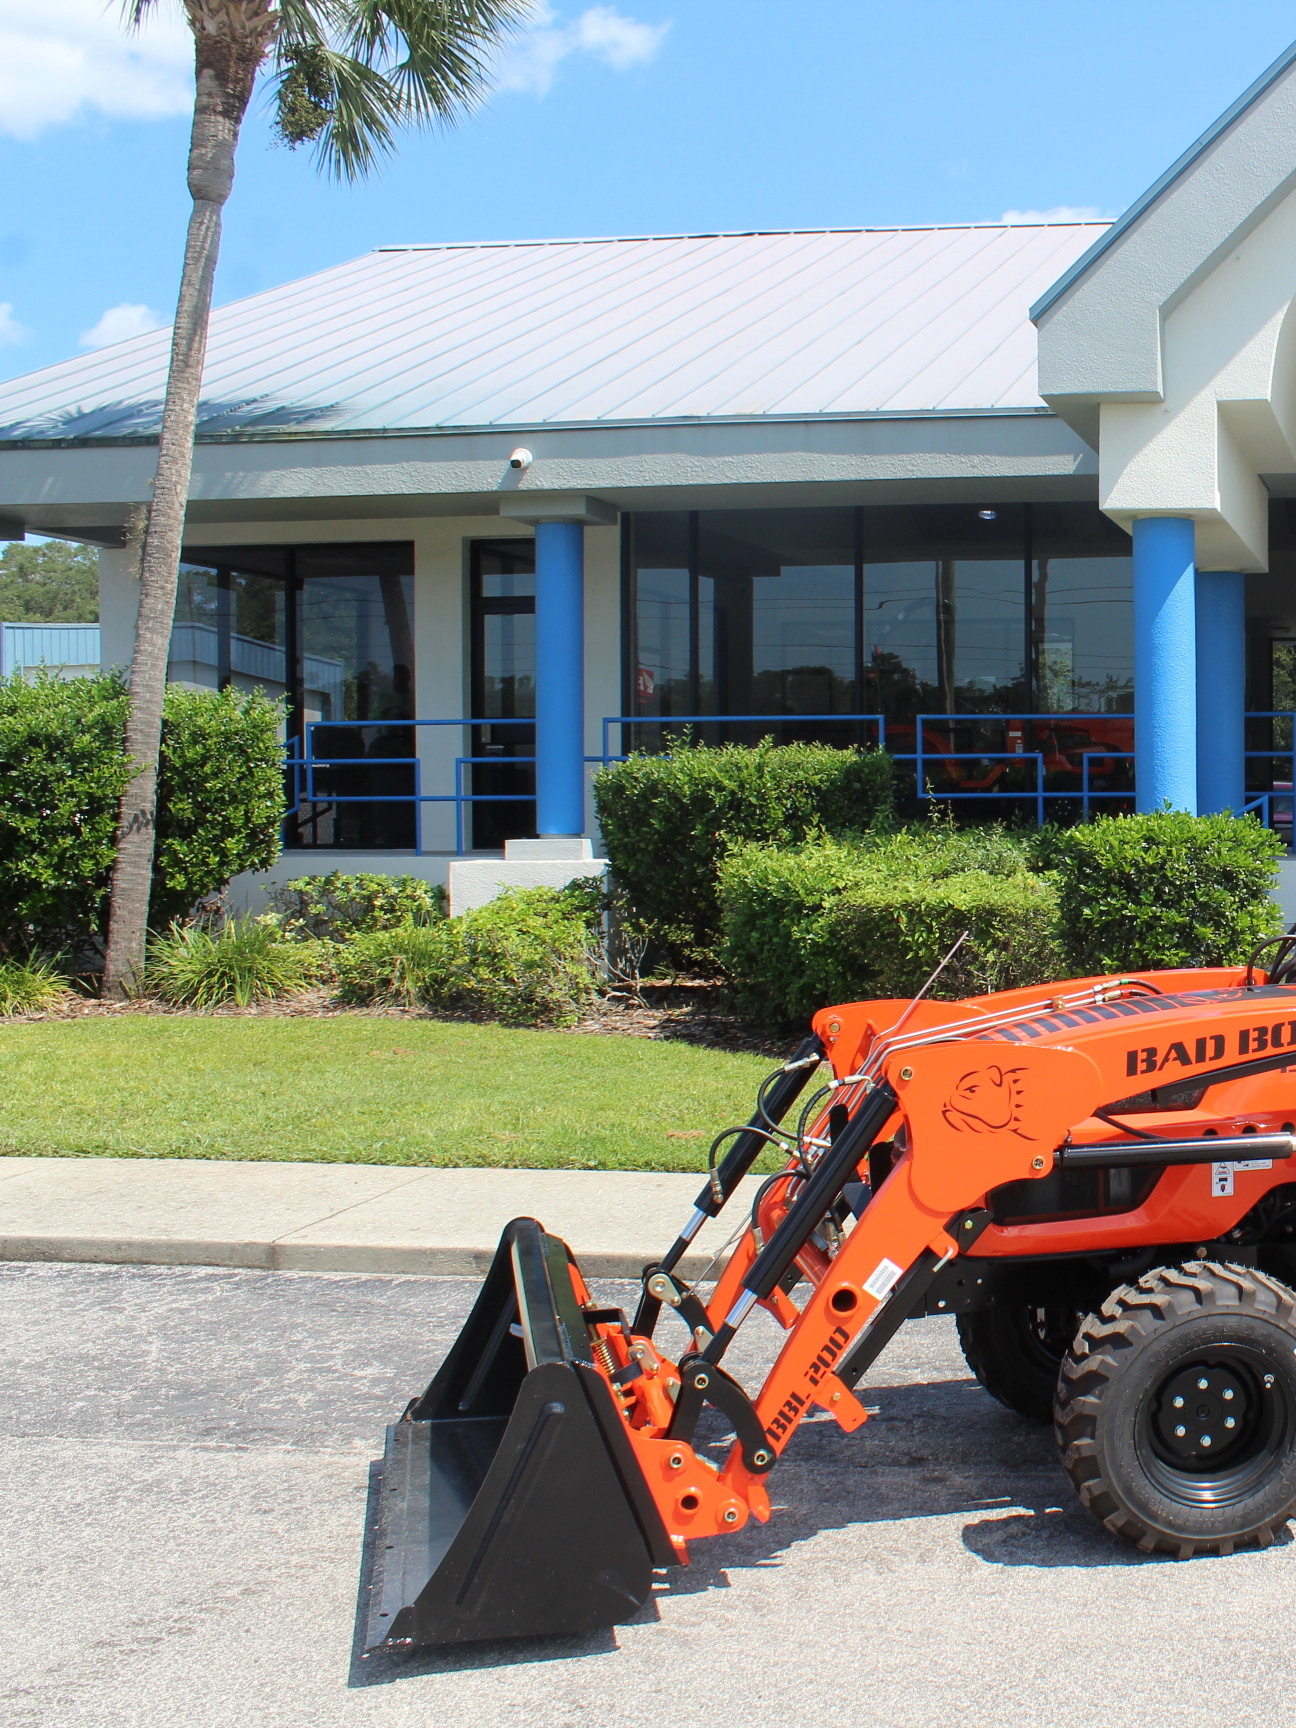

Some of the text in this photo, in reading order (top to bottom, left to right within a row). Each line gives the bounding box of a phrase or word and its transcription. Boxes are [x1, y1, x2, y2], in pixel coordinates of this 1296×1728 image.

[1126, 1034, 1226, 1077] BAD
[765, 1326, 850, 1442] BBL 200
